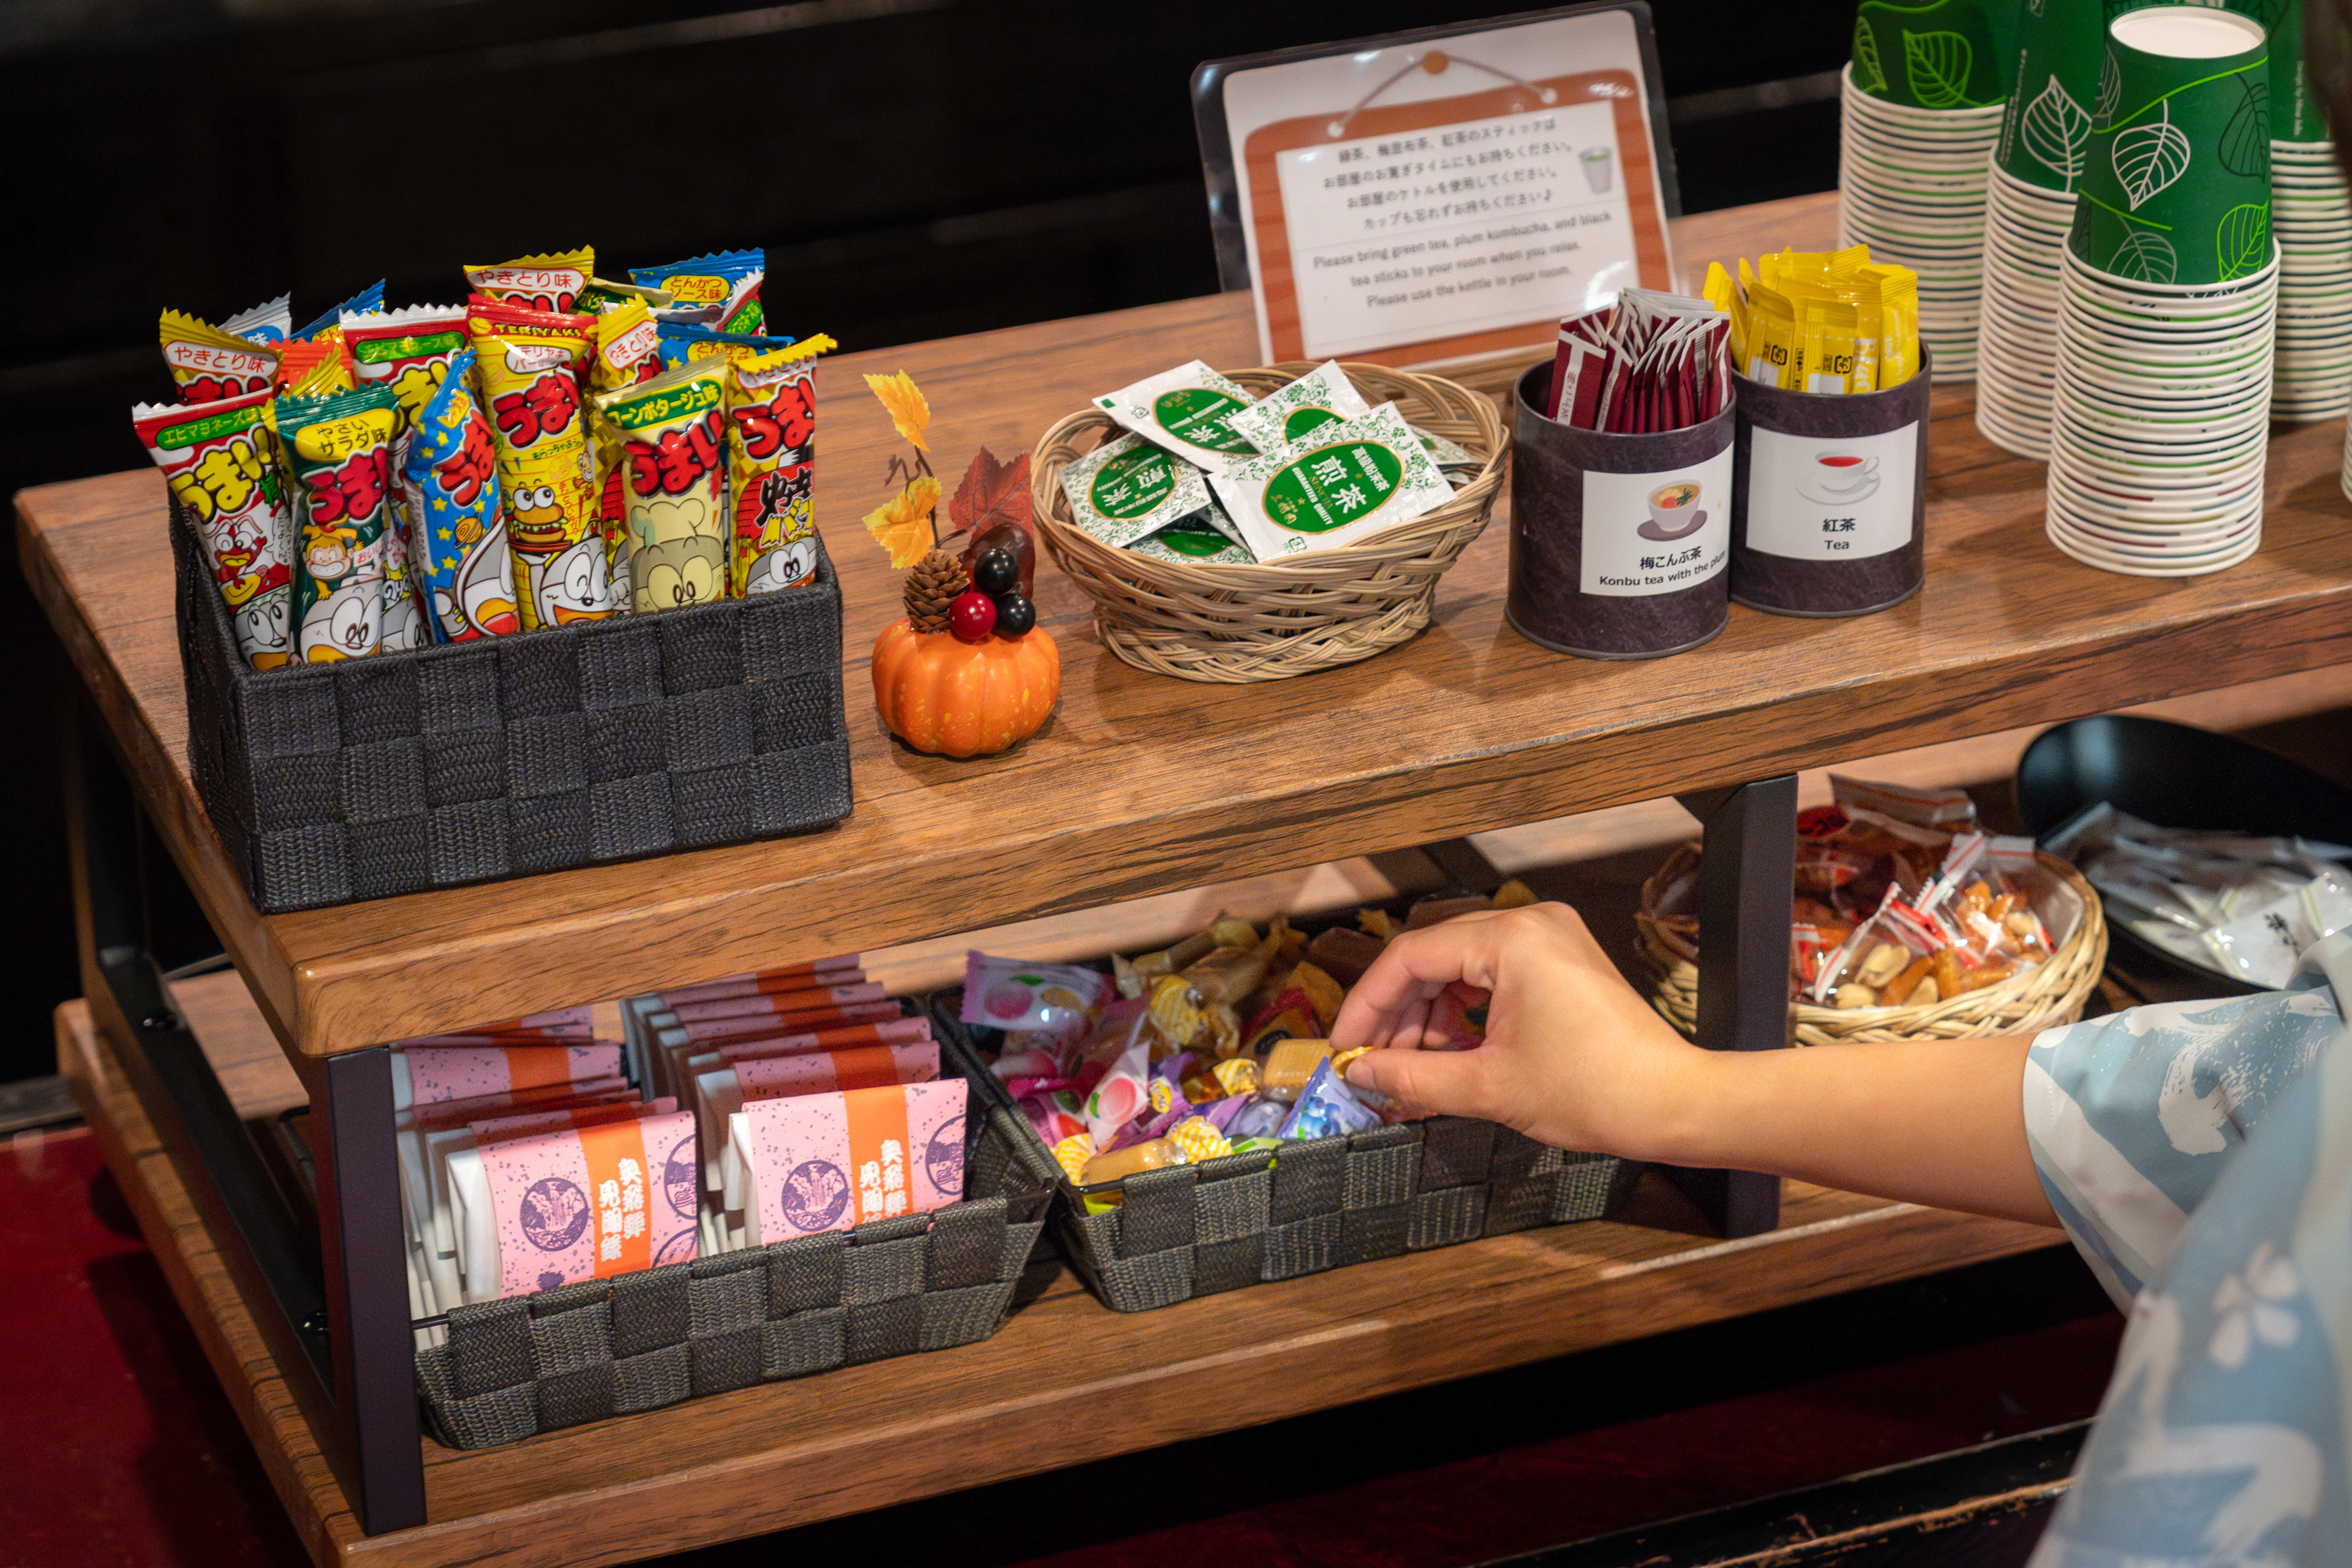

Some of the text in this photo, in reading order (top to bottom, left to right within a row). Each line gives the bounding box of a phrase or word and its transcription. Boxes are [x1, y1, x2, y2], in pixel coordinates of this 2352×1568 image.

[1314, 255, 1354, 269] Please
[1357, 249, 1389, 261] bring
[1392, 243, 1425, 258] green
[1454, 233, 1485, 247] plum
[1555, 217, 1577, 229] and
[1580, 210, 1611, 225] black
[477, 270, 573, 288] やきとり味
[1351, 276, 1371, 286] tea
[1374, 268, 1408, 283] sticks
[1411, 266, 1424, 276] to
[1428, 262, 1453, 275] your
[1456, 256, 1487, 268] room
[1490, 250, 1523, 263] when
[1526, 247, 1547, 260] you
[671, 277, 722, 288] とんかつ
[671, 289, 722, 300] ソース味
[1367, 293, 1408, 306] Please
[1411, 288, 1433, 300] use
[1436, 284, 1456, 296] the
[1458, 277, 1492, 292] kettle
[1496, 276, 1507, 286] in
[1510, 272, 1536, 286] your
[494, 324, 581, 337] TERIYAKI
[609, 326, 655, 364] やきとり味
[175, 346, 266, 373] やきとり味
[606, 384, 720, 427] コーンポタージュ味
[316, 420, 370, 439] やさい
[318, 428, 386, 457] サラダ味
[1351, 446, 1390, 492] 高級粉末茶
[1292, 467, 1334, 525] GUARANTEED QUALITY
[1309, 476, 1334, 510] SENCHA
[1311, 455, 1367, 514] 煎茶
[1822, 518, 1856, 532] 紅茶
[1640, 546, 1702, 570] 梅こんぶ茶
[1824, 540, 1849, 549] Tea
[1600, 576, 1640, 586] Konbu
[1645, 576, 1664, 585] tea
[1668, 569, 1691, 582] with
[1694, 563, 1708, 575] the
